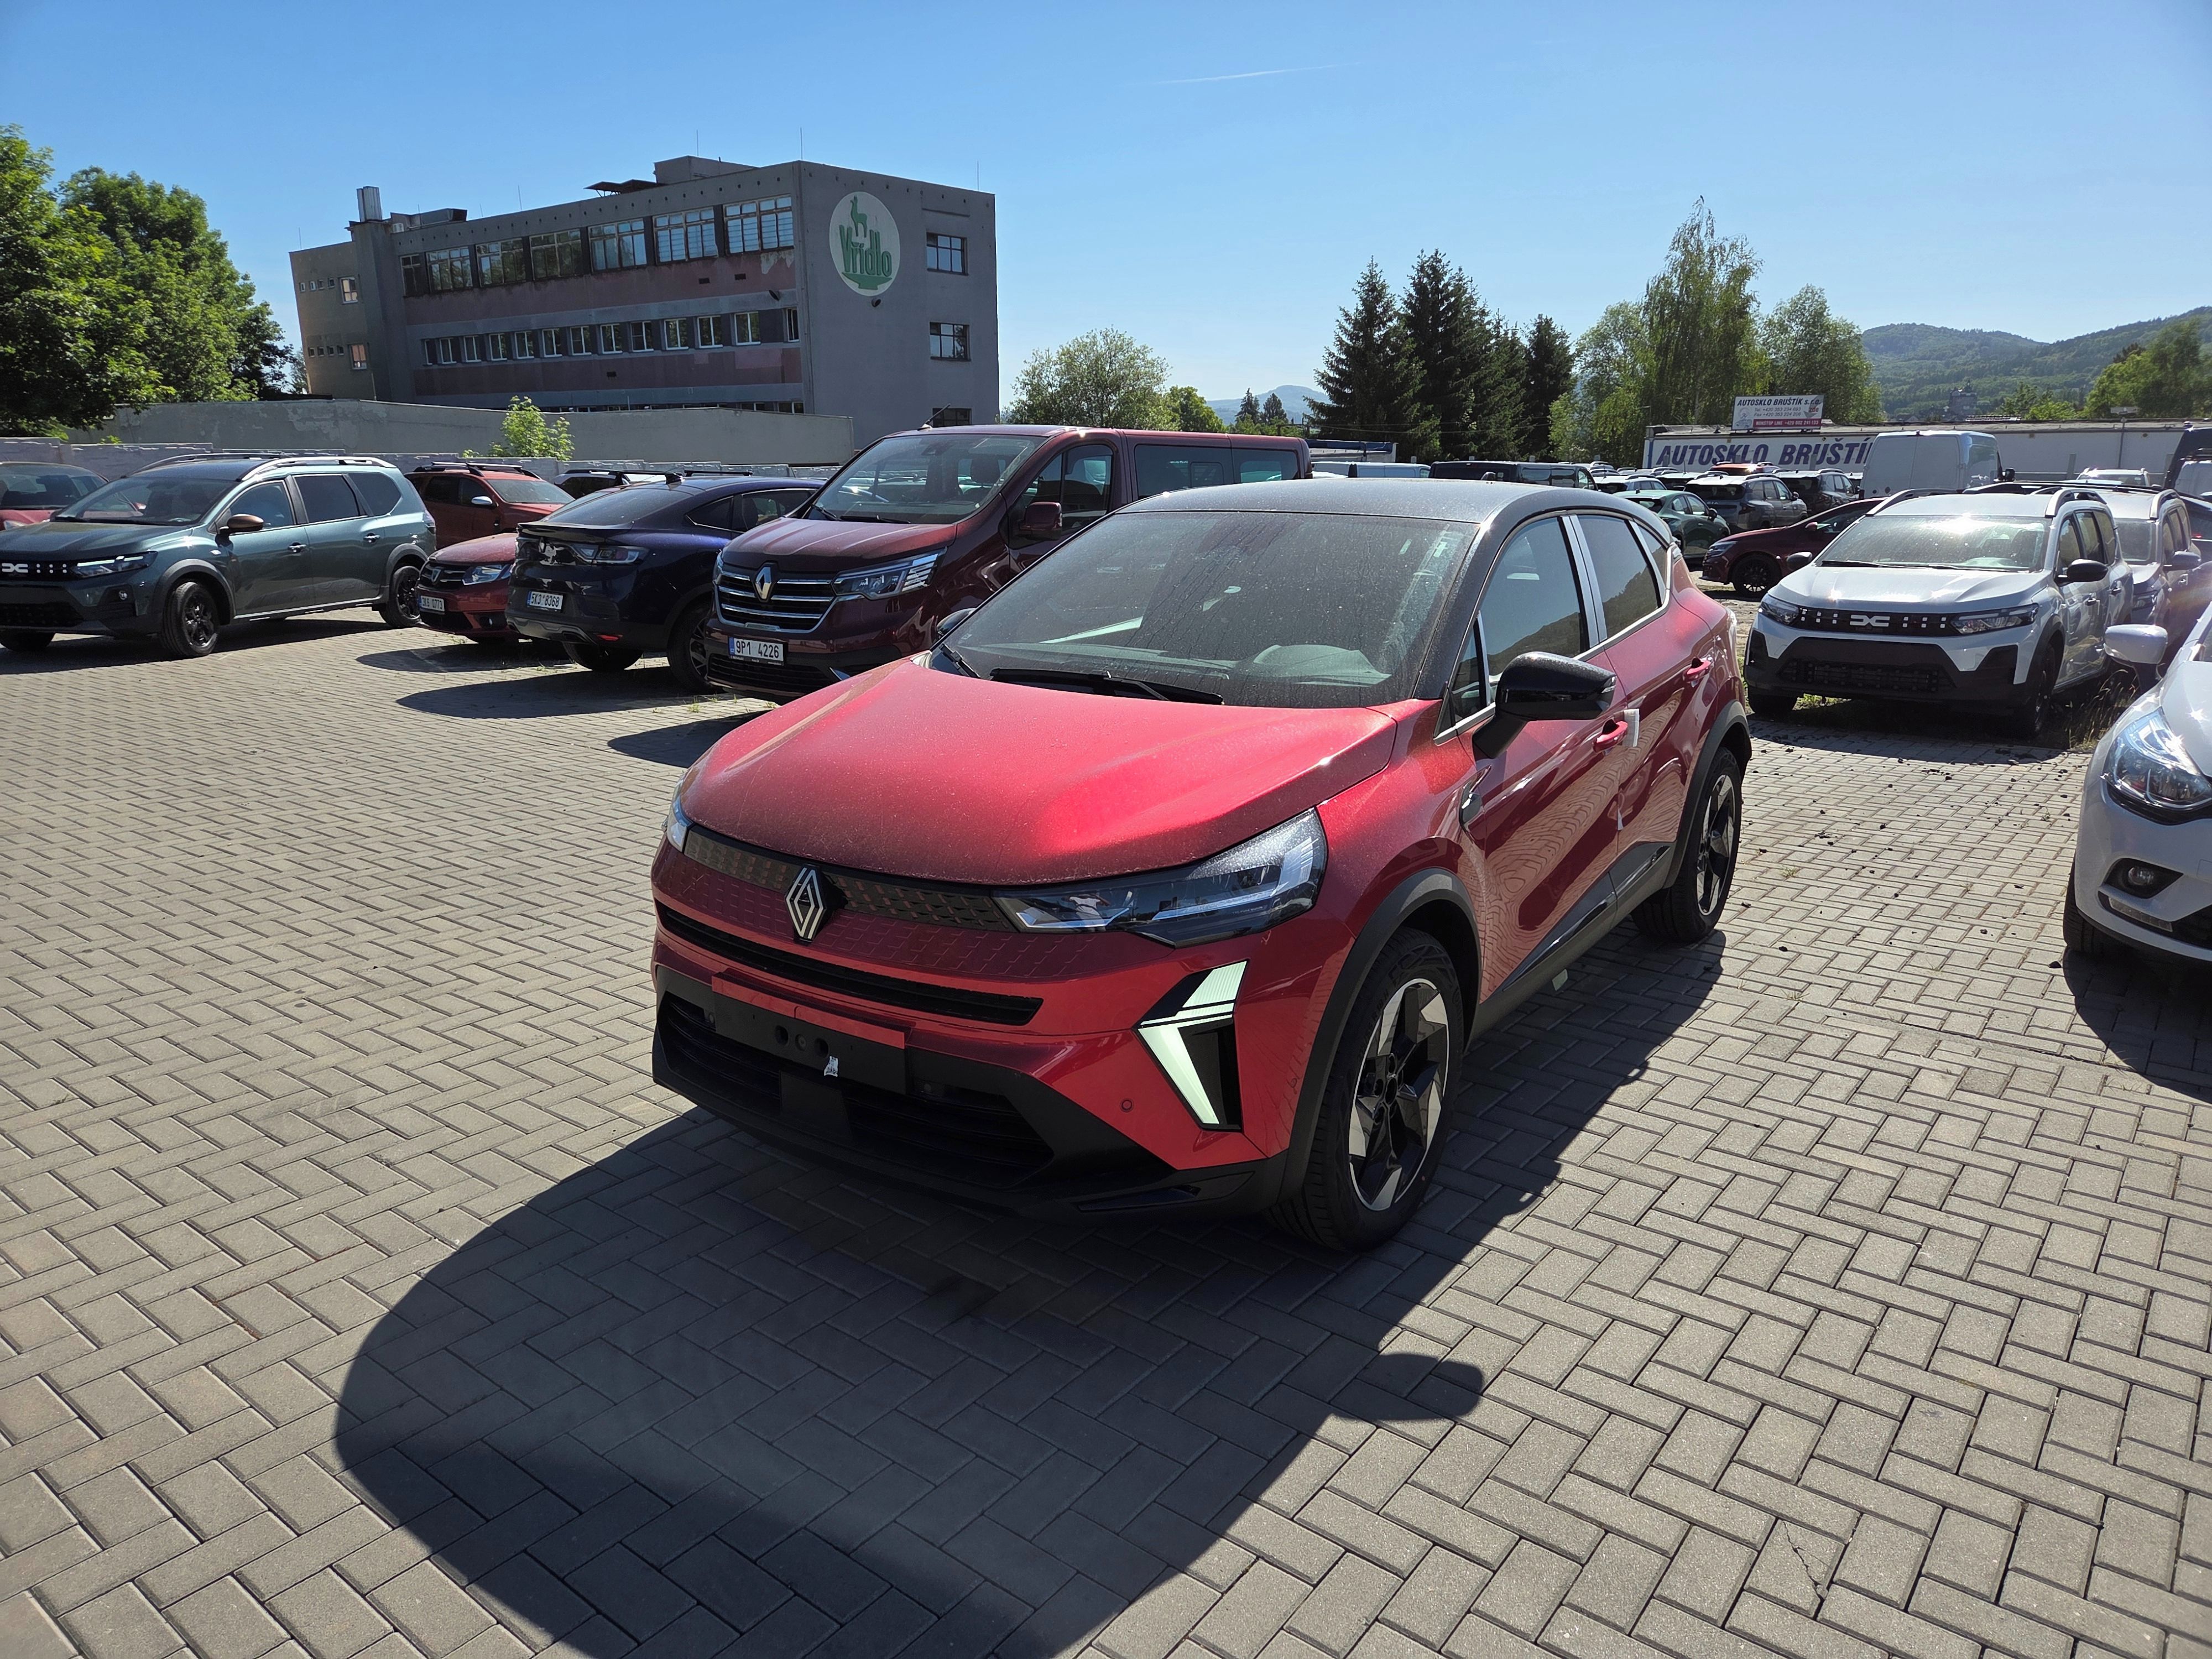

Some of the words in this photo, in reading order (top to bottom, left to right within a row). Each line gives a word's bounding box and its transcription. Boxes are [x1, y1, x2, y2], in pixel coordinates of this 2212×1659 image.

[1773, 397, 1803, 405] BRUŠTÍK
[1656, 444, 1768, 466] AUTOSKLO
[1778, 437, 1872, 465] BRUŠTÍ
[531, 593, 541, 604] 5K3
[545, 595, 560, 607] 8368
[736, 640, 751, 655] 9P1
[758, 643, 779, 659] 4226
